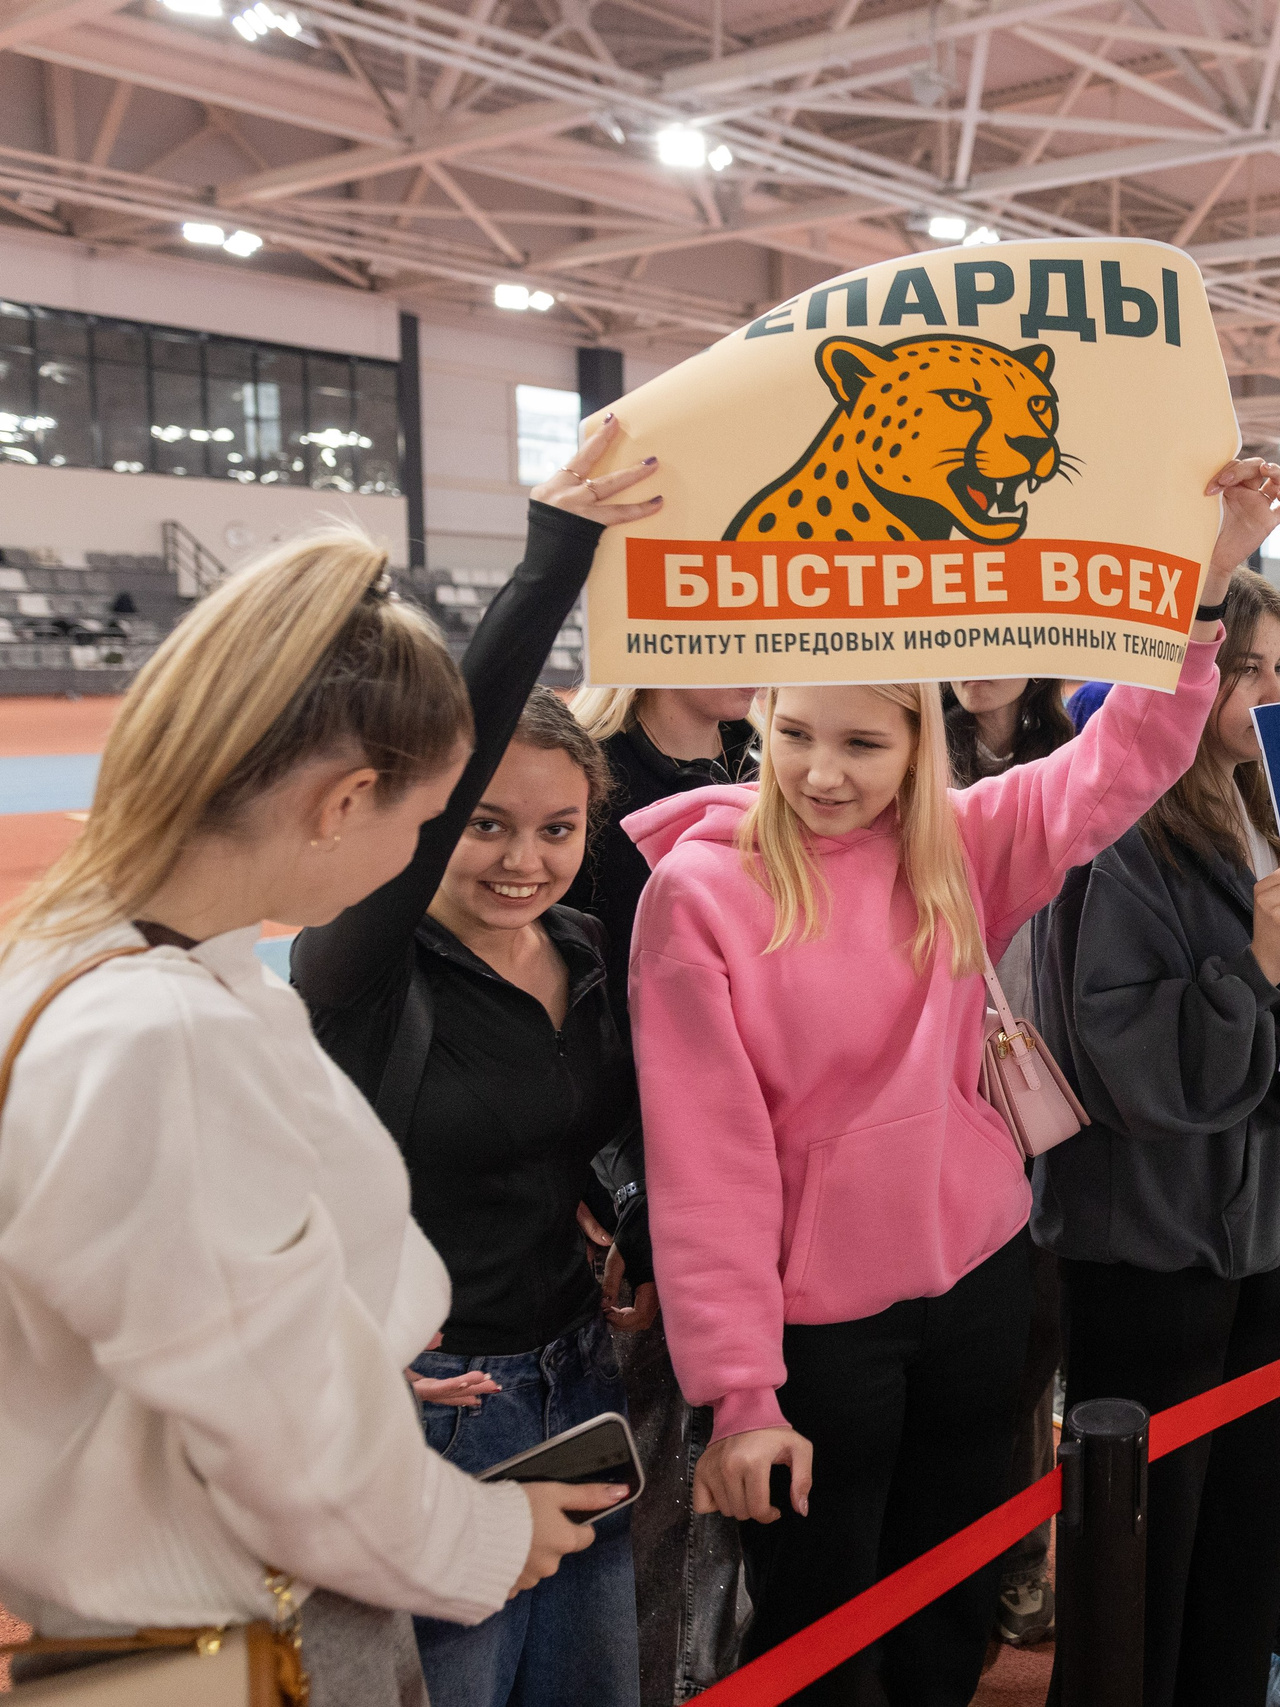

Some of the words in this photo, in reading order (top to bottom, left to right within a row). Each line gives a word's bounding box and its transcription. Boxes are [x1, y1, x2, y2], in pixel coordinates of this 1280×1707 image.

[743, 258, 1182, 347] ЕПАРДЫ
[664, 552, 1008, 608] БЫСТРЕЕ
[1041, 551, 1183, 620] ВСЕХ
[627, 633, 746, 654] ИНСТИТУТ
[755, 631, 895, 655] ПЕРЕДОВЫХ
[904, 626, 1117, 651] ИНФОРМАЦИОННЫХ
